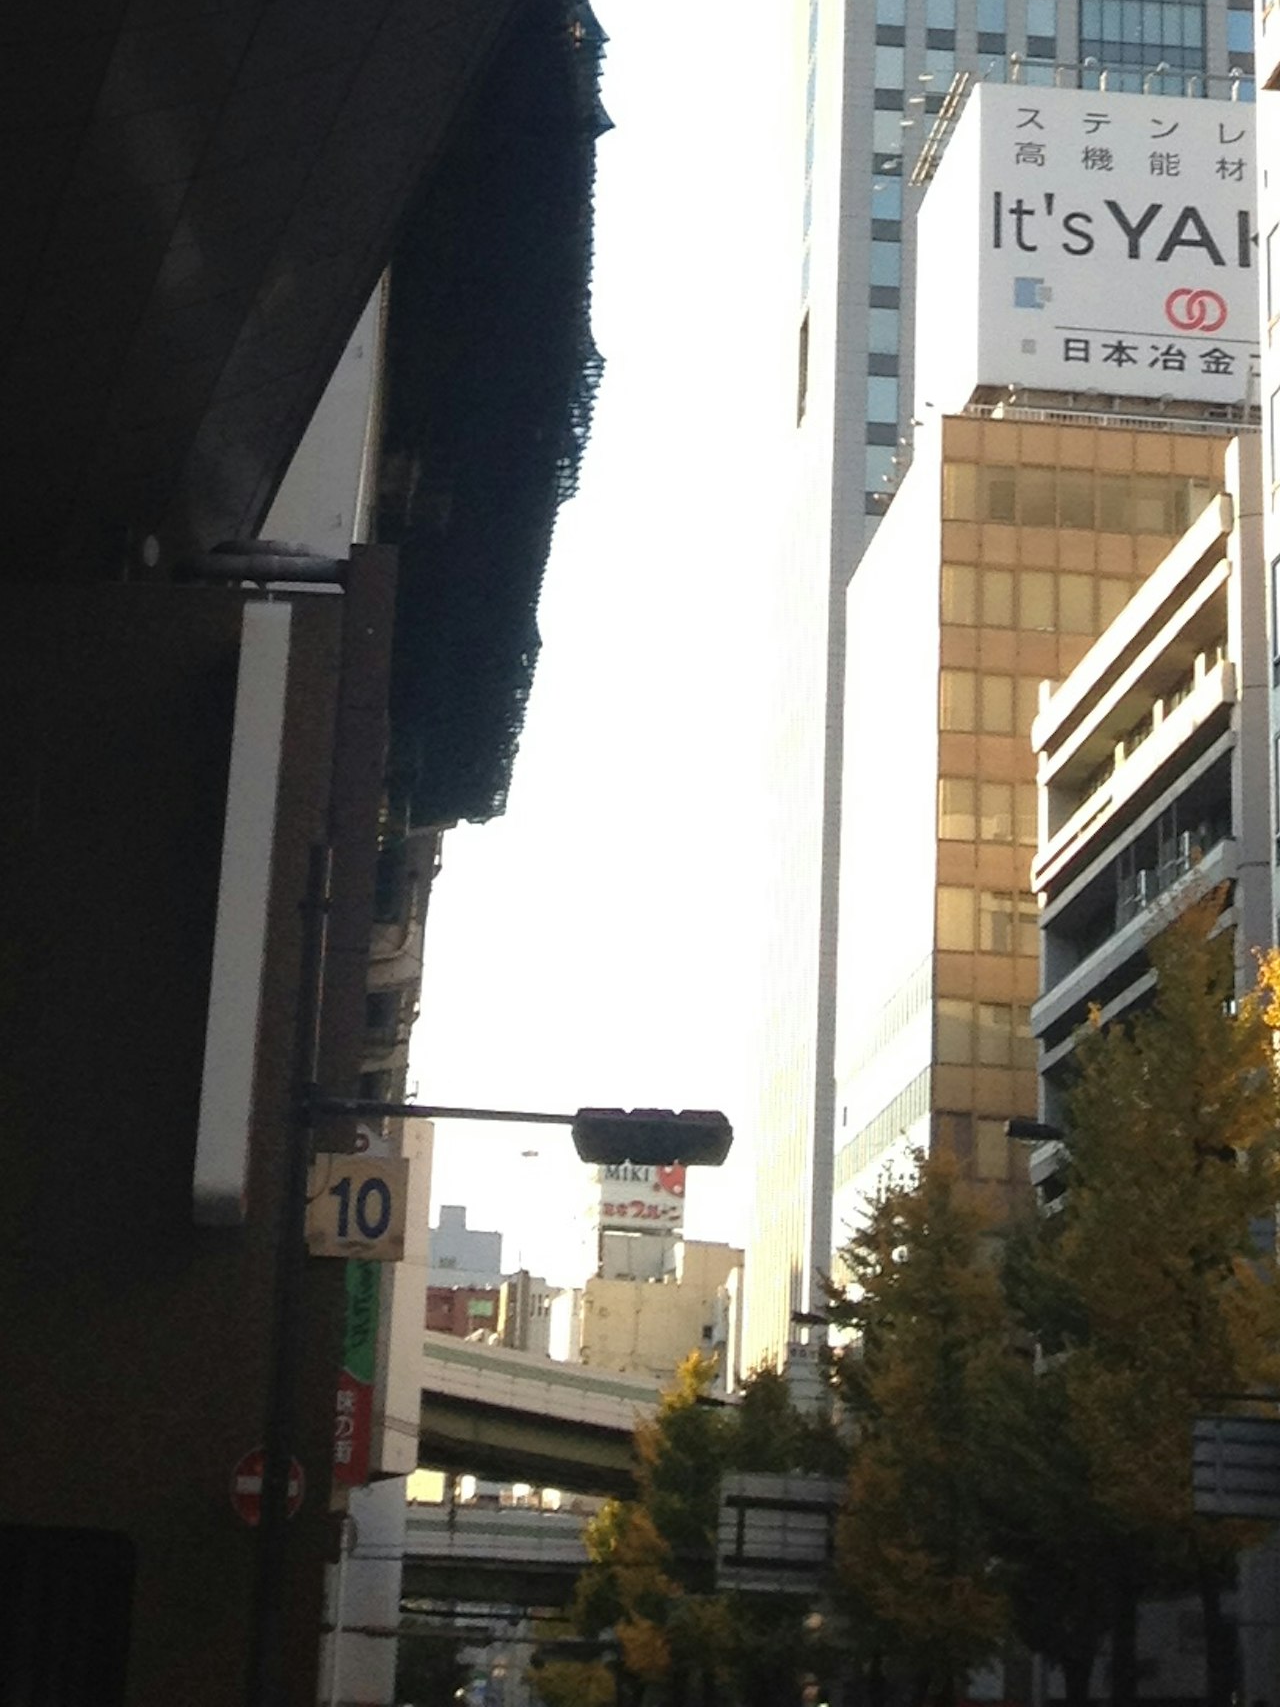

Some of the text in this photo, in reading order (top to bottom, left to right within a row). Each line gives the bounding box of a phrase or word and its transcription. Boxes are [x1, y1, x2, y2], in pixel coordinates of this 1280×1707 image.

[1014, 140, 1248, 183] 高機能材
[604, 1163, 650, 1182] MIKI
[329, 1176, 392, 1240] 10
